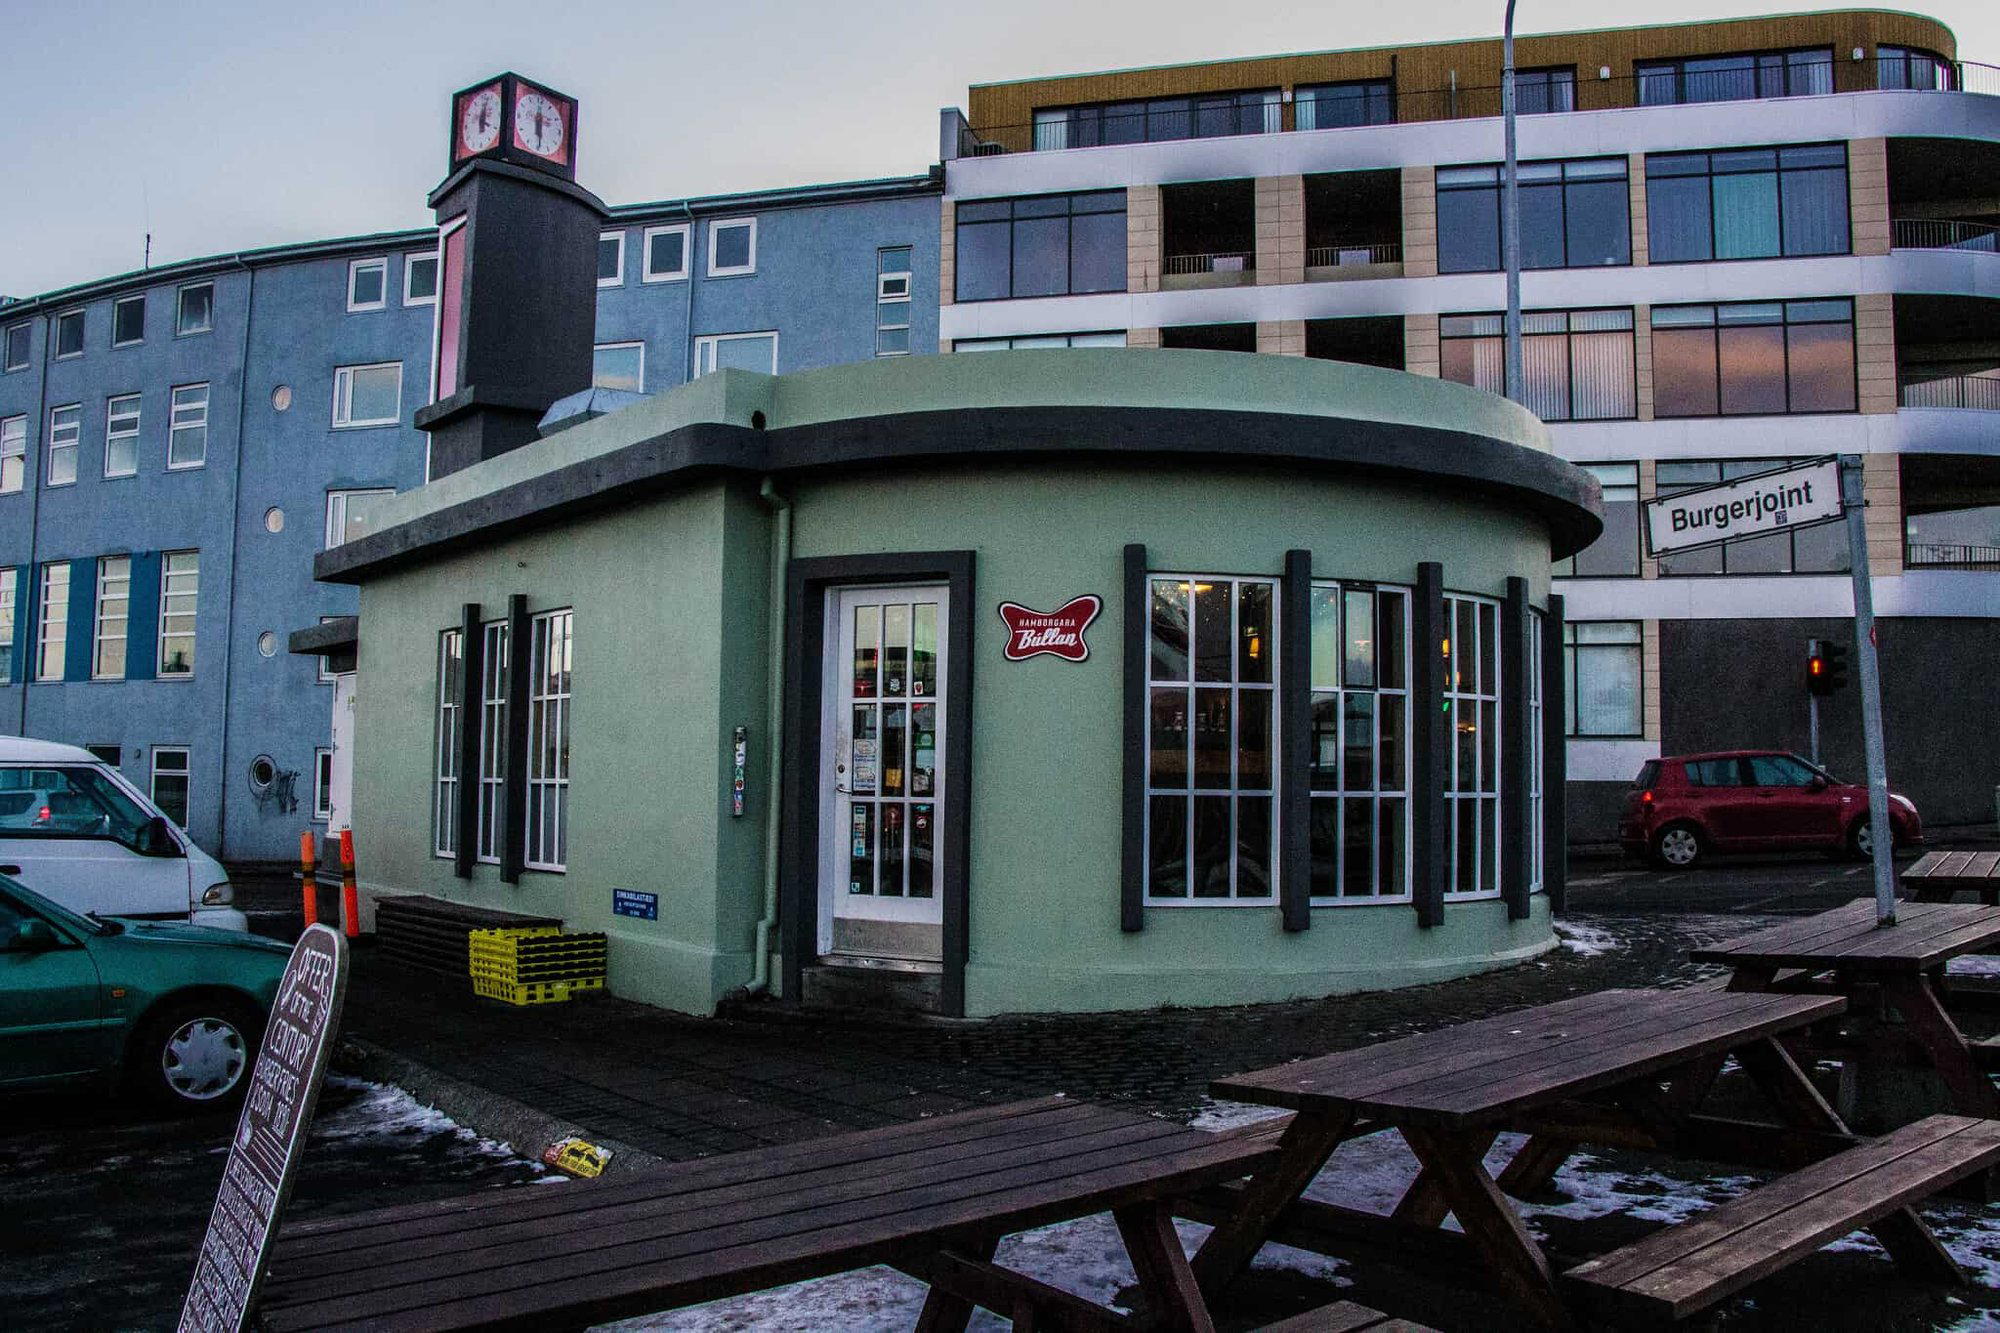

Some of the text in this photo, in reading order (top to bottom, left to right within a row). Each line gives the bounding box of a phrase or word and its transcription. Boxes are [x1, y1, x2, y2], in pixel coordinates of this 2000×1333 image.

[1671, 480, 1813, 532] Burgerjoint
[1015, 627, 1078, 650] Búllan
[1019, 618, 1076, 627] HAMBORGARA
[297, 947, 332, 993] OFFER
[269, 1017, 314, 1073] CENTURY
